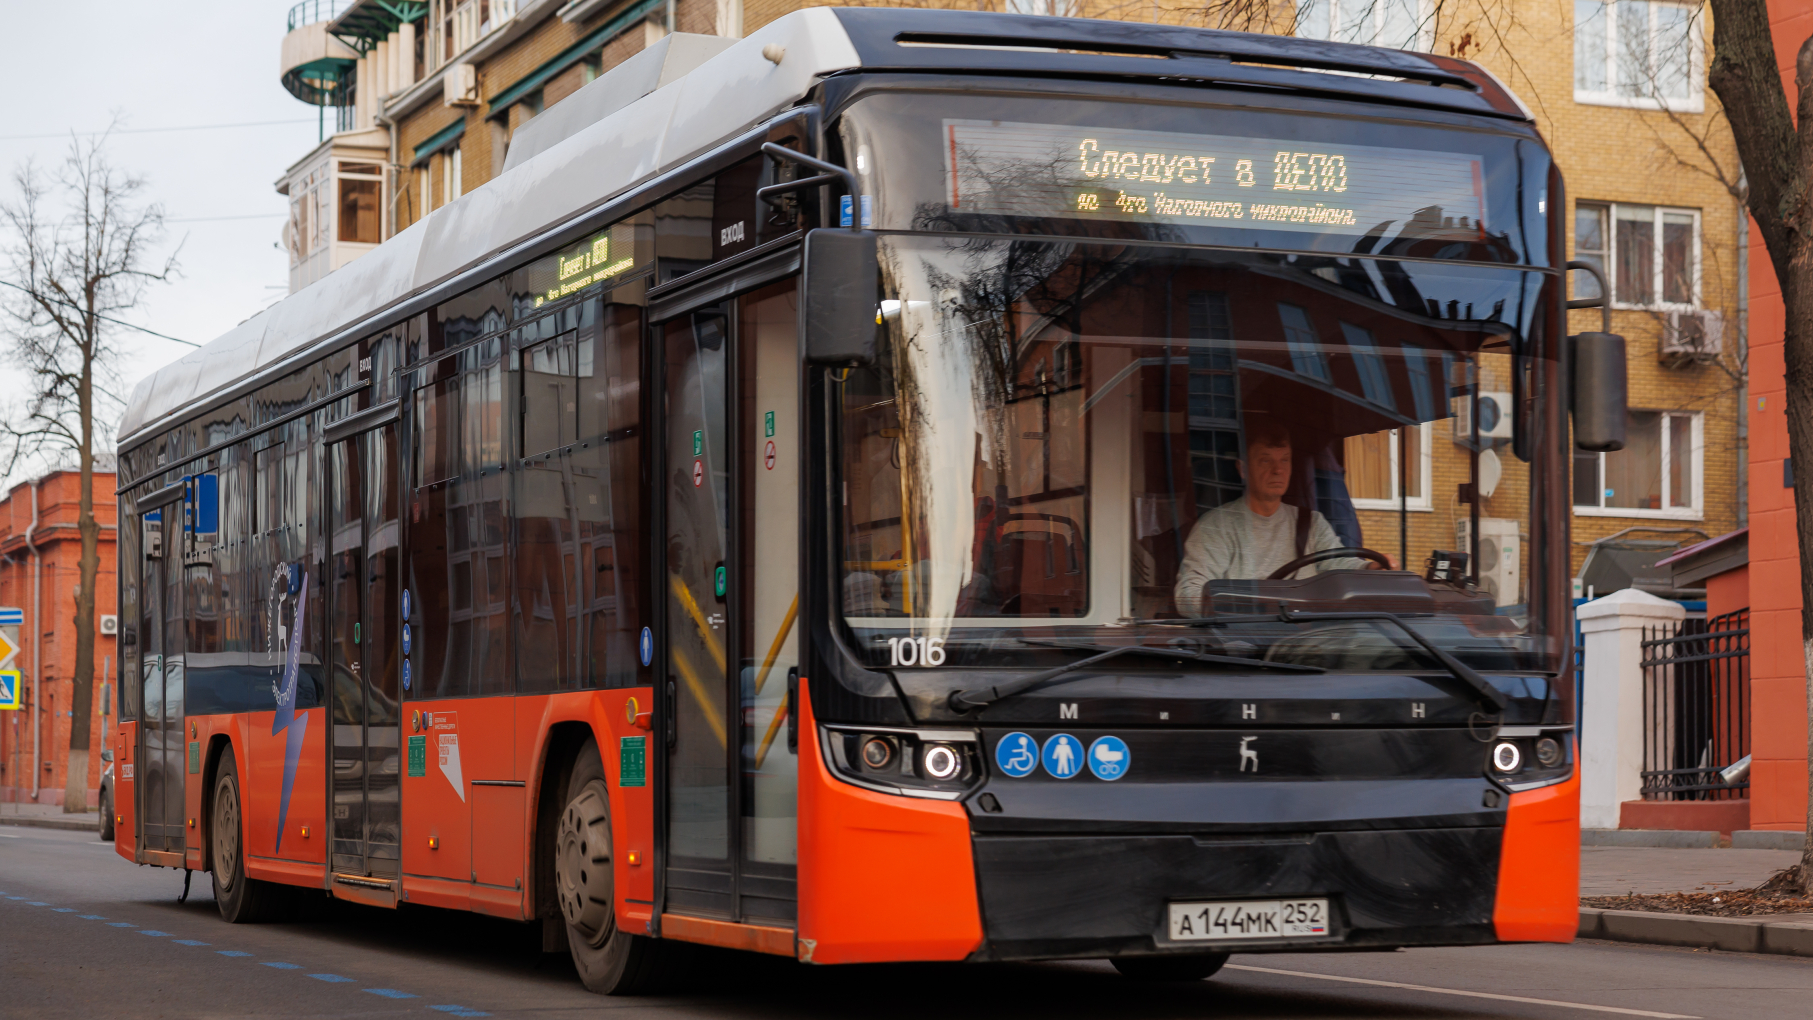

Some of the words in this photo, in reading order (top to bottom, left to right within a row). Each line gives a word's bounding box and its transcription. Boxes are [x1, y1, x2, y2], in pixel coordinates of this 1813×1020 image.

[1079, 138, 1216, 185] Следует
[1235, 158, 1256, 188] в
[1273, 151, 1348, 193] ДЕПО
[721, 220, 745, 247] ВХОД
[888, 637, 946, 666] 1016
[1283, 903, 1322, 924] 252
